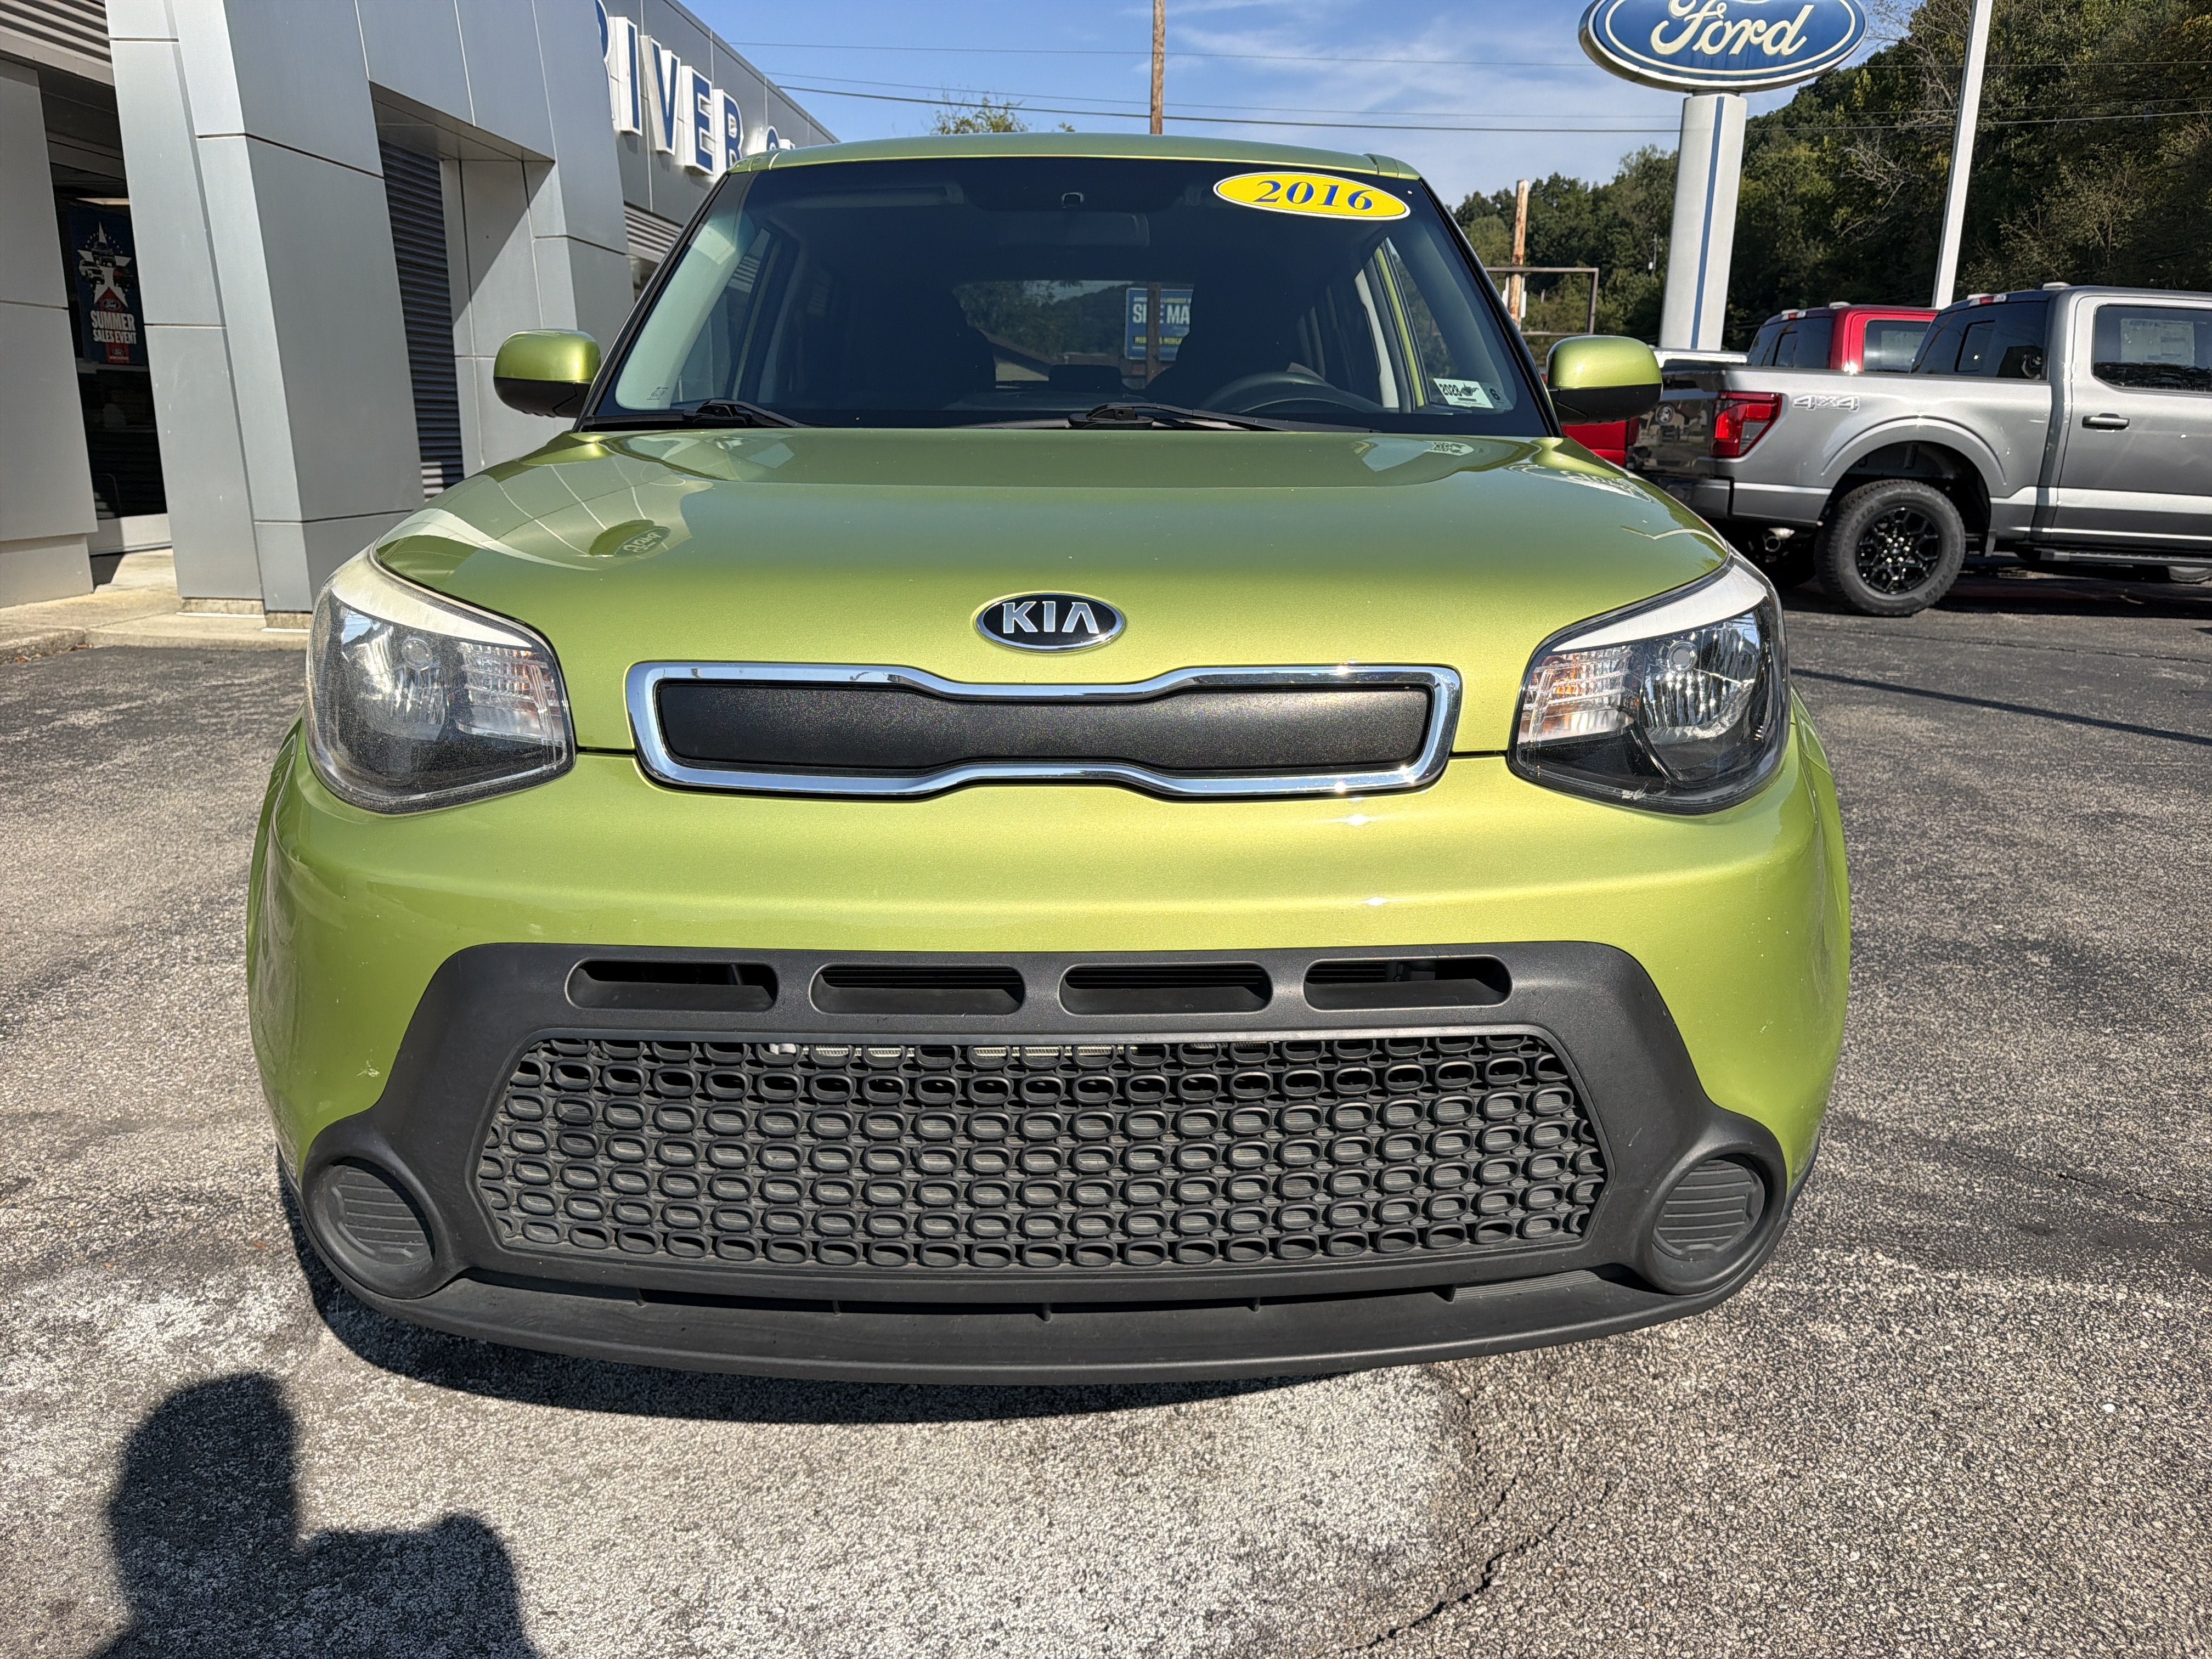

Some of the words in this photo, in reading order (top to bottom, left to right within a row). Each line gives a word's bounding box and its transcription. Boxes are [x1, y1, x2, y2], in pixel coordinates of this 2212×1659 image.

[1650, 0, 1815, 55] Ford
[1252, 180, 1374, 210] 2016
[90, 310, 136, 331] SUMMER
[93, 329, 115, 343] SALES
[114, 330, 137, 345] EVENT
[1489, 388, 1500, 400] 6
[1002, 601, 1100, 634] KIA
